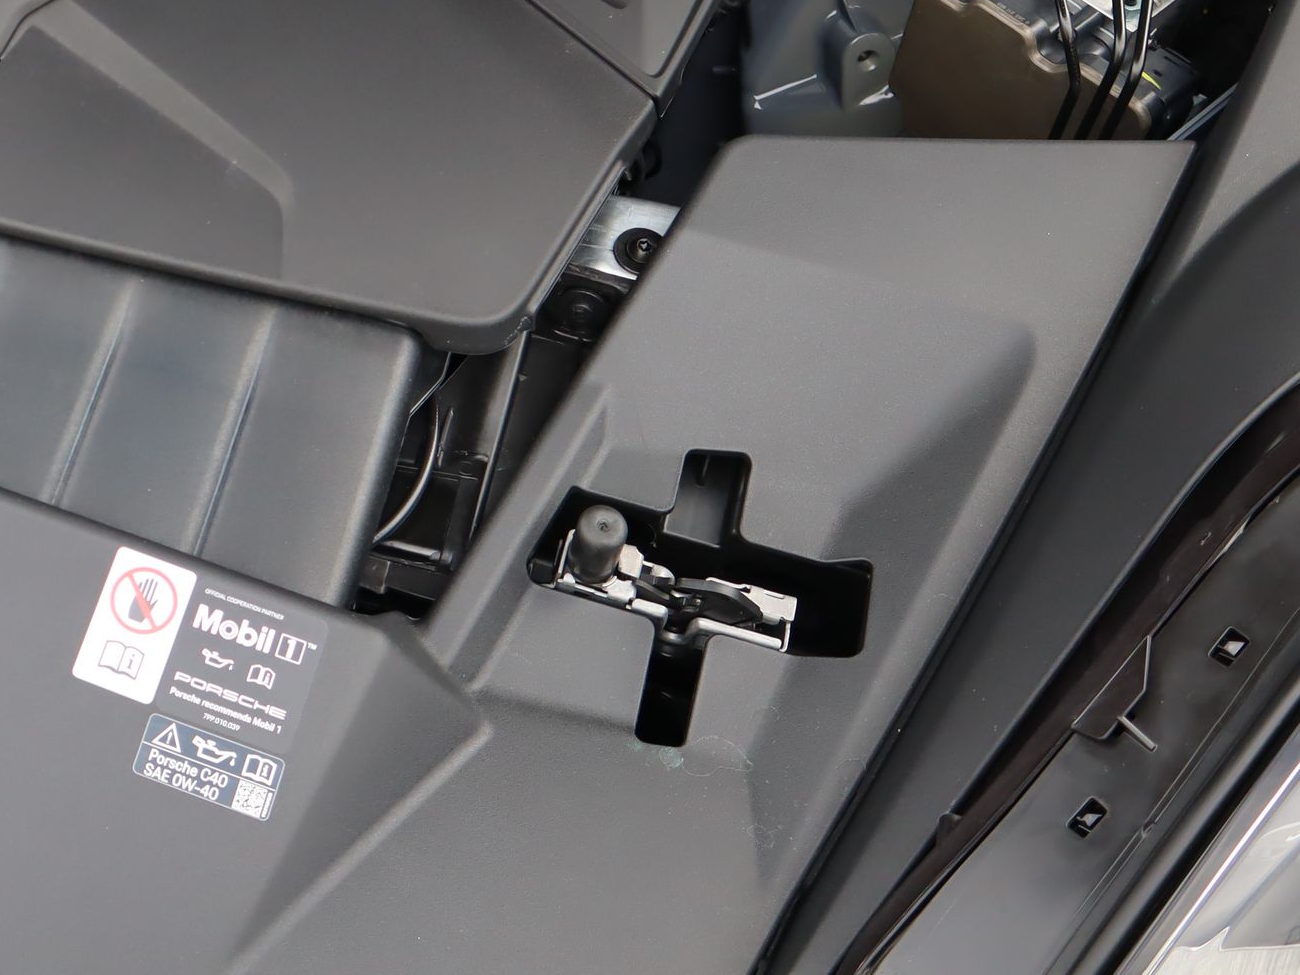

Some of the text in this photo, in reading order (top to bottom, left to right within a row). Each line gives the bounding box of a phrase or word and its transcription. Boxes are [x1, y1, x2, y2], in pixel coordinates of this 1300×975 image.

[205, 588, 284, 620] OFFICIAL COOPERATION PARTNER
[192, 604, 275, 654] Mobil
[170, 686, 282, 734] Porsche recommends Mobil 1
[174, 671, 287, 721] PORSCHE
[144, 763, 219, 801] SAE 0W-40
[148, 749, 228, 788] Porsche C40
